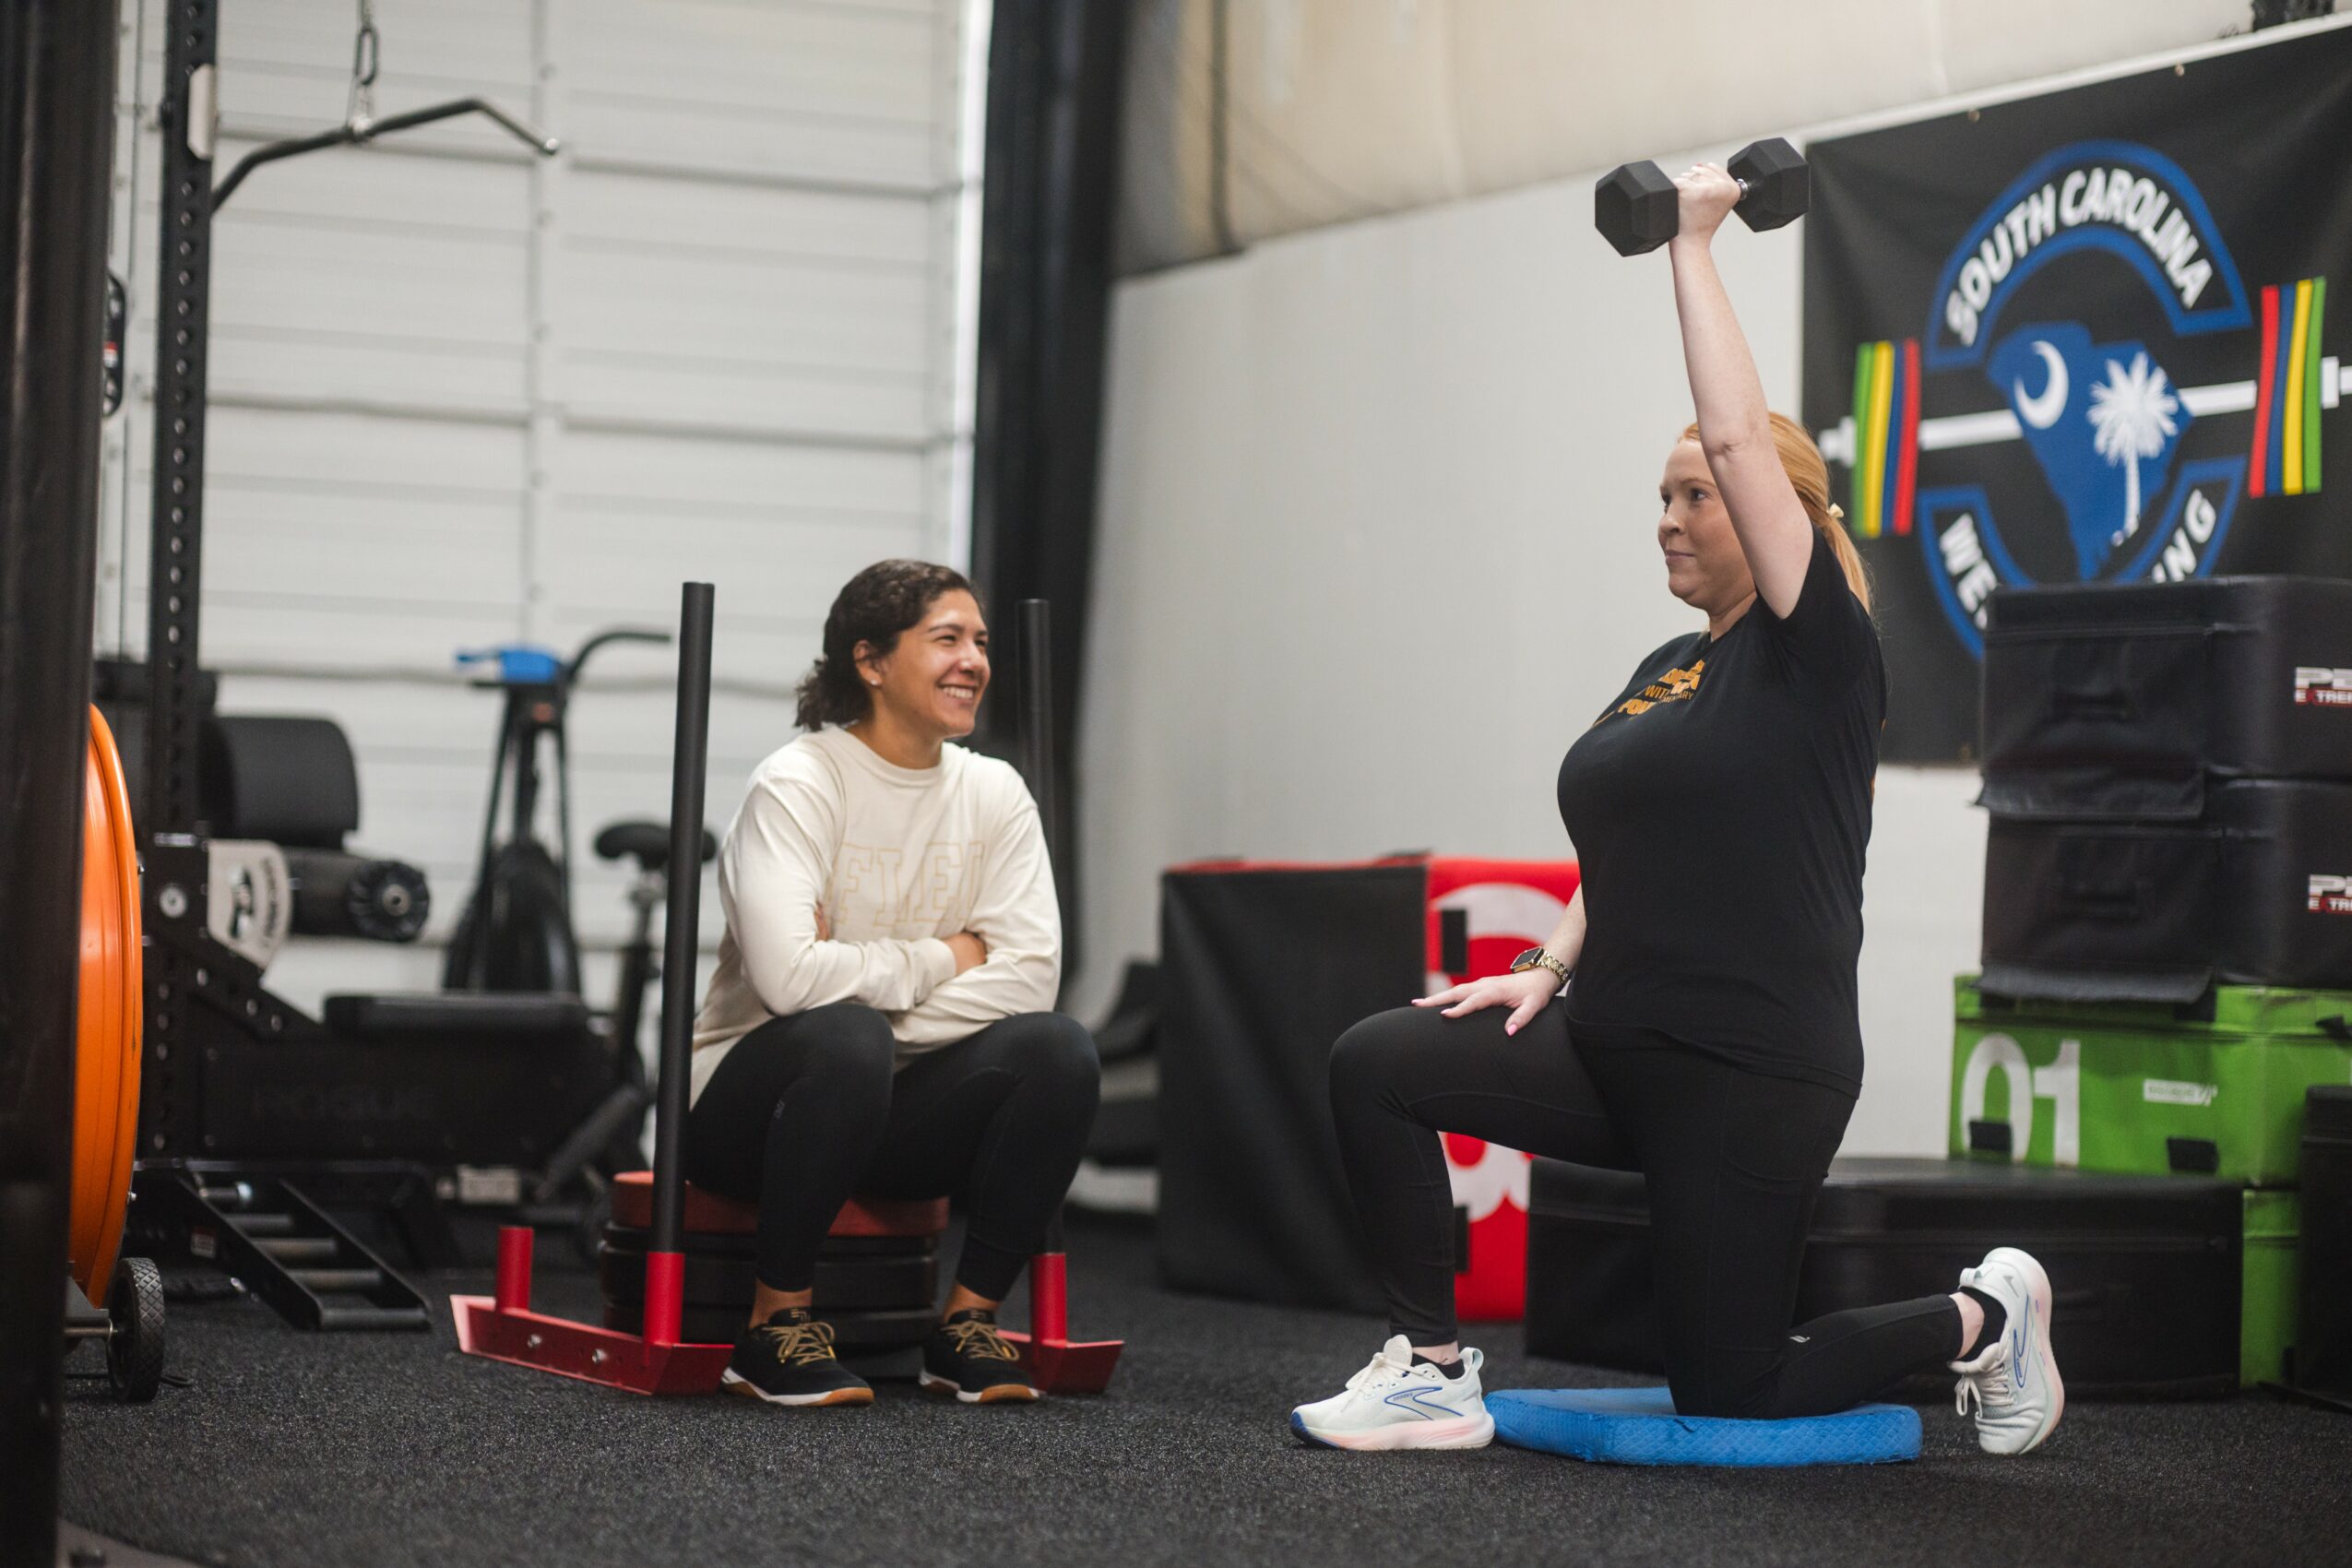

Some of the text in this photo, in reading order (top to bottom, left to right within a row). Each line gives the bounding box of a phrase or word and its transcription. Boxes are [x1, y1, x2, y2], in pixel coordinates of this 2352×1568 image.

[1946, 167, 2213, 348] SOUTH CAROLINA
[1960, 1032, 2081, 1167] 01
